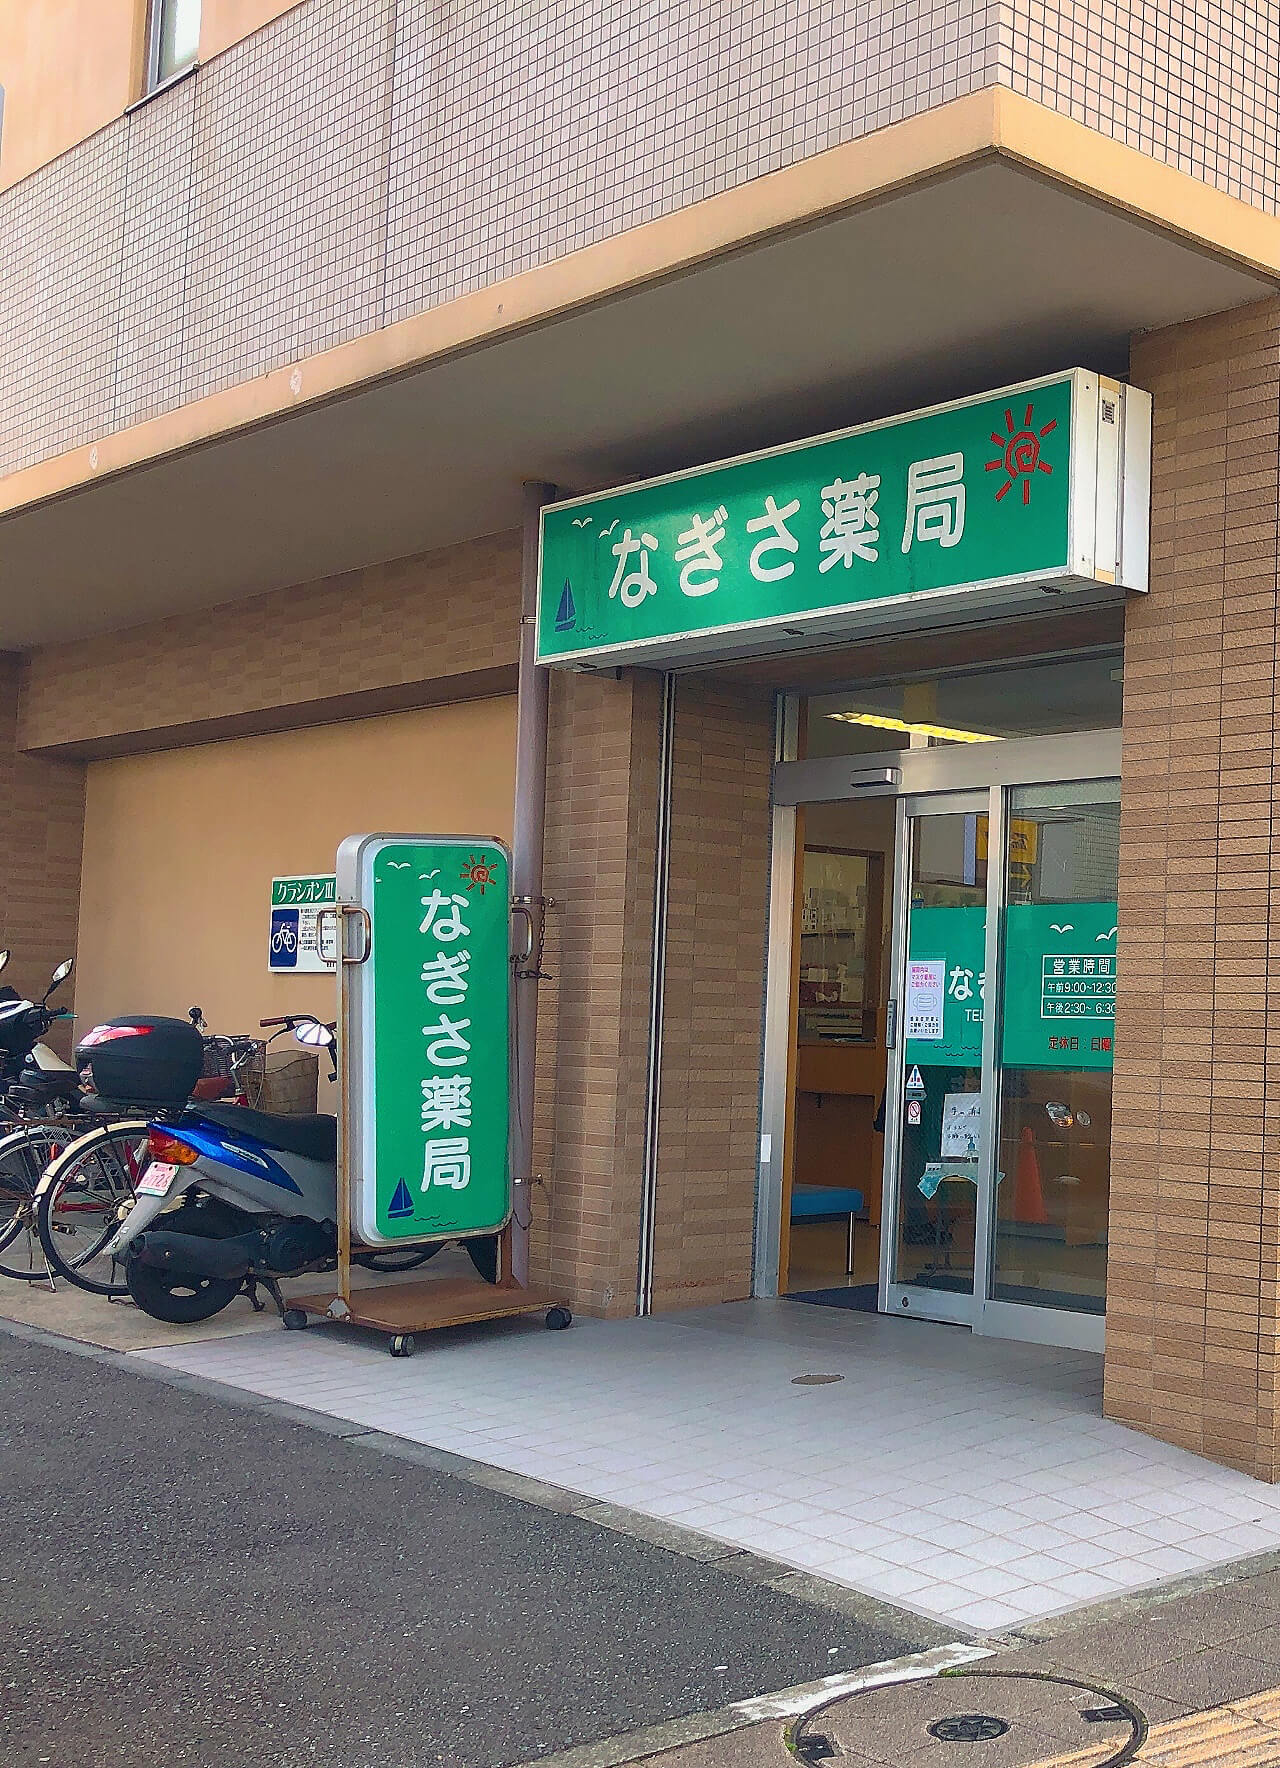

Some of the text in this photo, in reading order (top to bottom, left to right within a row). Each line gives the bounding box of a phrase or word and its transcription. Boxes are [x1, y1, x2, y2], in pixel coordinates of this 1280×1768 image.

[608, 451, 967, 609] なぎさ薬局
[418, 888, 473, 1193] なぎさ薬局
[1053, 958, 1111, 975] 営業時間
